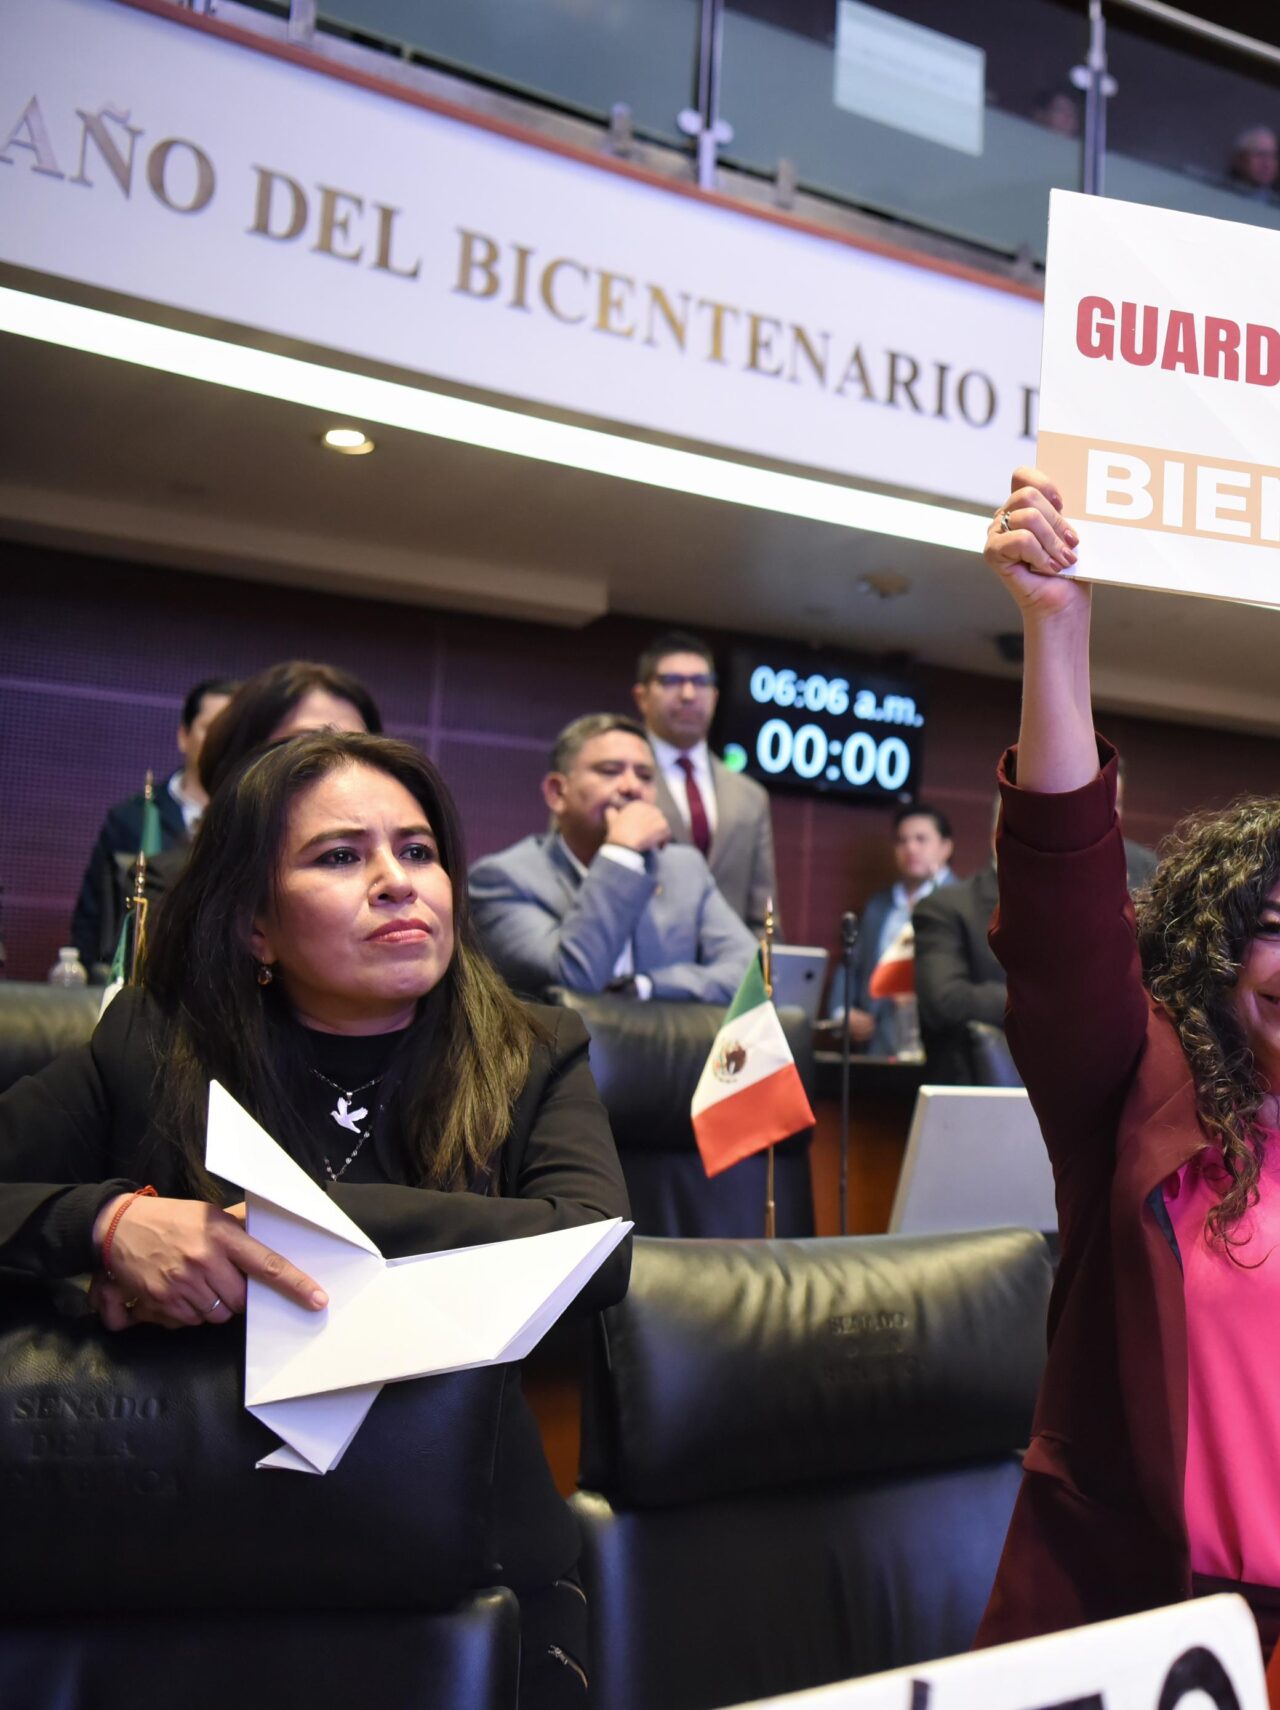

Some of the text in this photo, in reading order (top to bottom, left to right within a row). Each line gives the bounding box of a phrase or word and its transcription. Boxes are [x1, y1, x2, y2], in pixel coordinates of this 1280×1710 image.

[0, 95, 216, 215] AÑO
[245, 163, 422, 279] DEL
[451, 226, 998, 428] BICENTENARIO
[750, 665, 925, 728] 06:06 a.m.
[756, 718, 911, 790] 00:00
